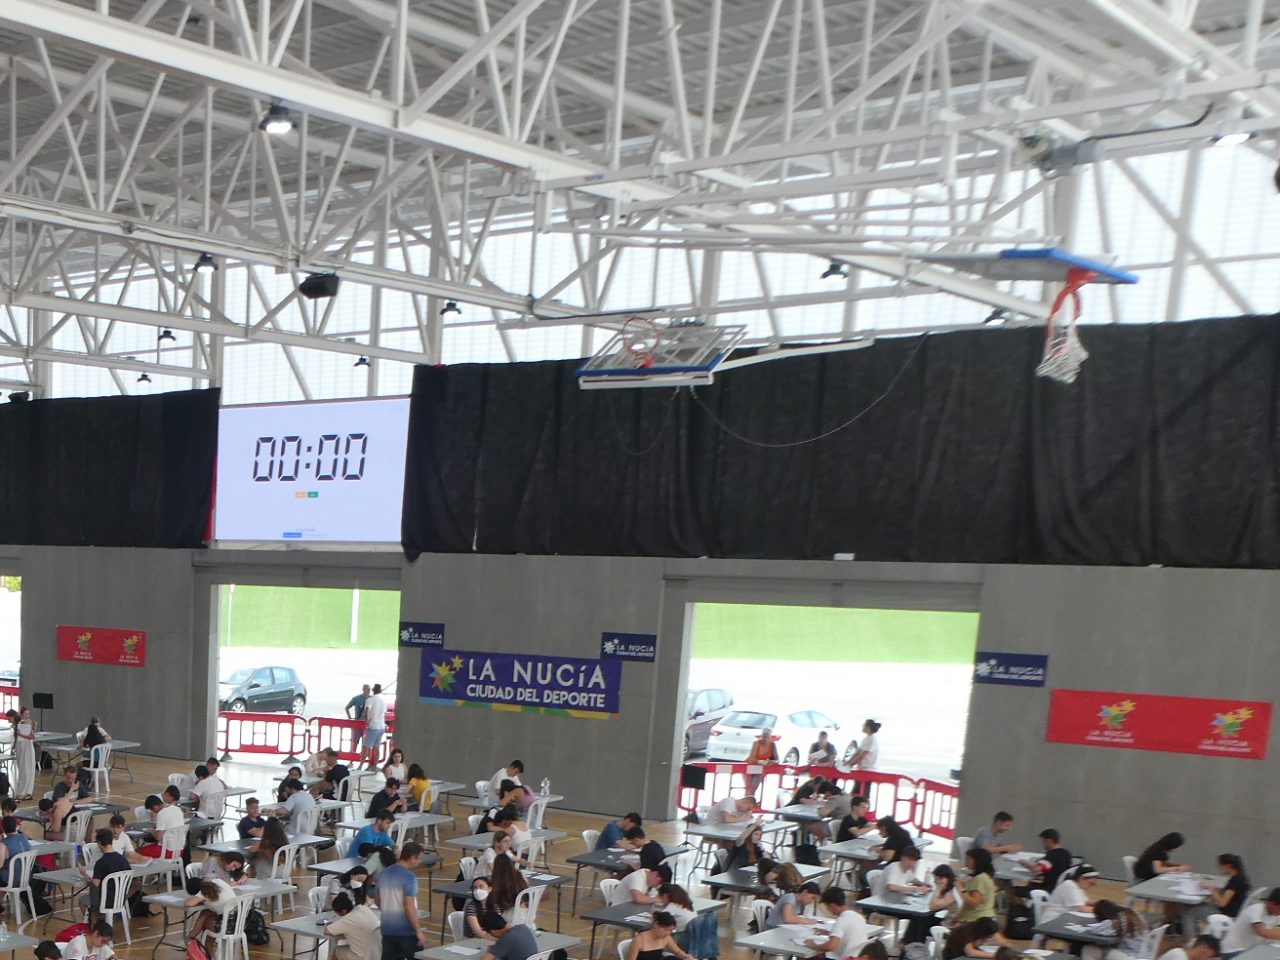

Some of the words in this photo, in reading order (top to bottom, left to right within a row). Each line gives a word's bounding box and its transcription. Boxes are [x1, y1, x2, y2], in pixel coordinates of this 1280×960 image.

[252, 433, 368, 482] 00:00
[468, 658, 496, 682] LA
[466, 683, 514, 700] CIUDAD
[516, 687, 540, 703] DEL
[543, 690, 606, 708] DEPORTE
